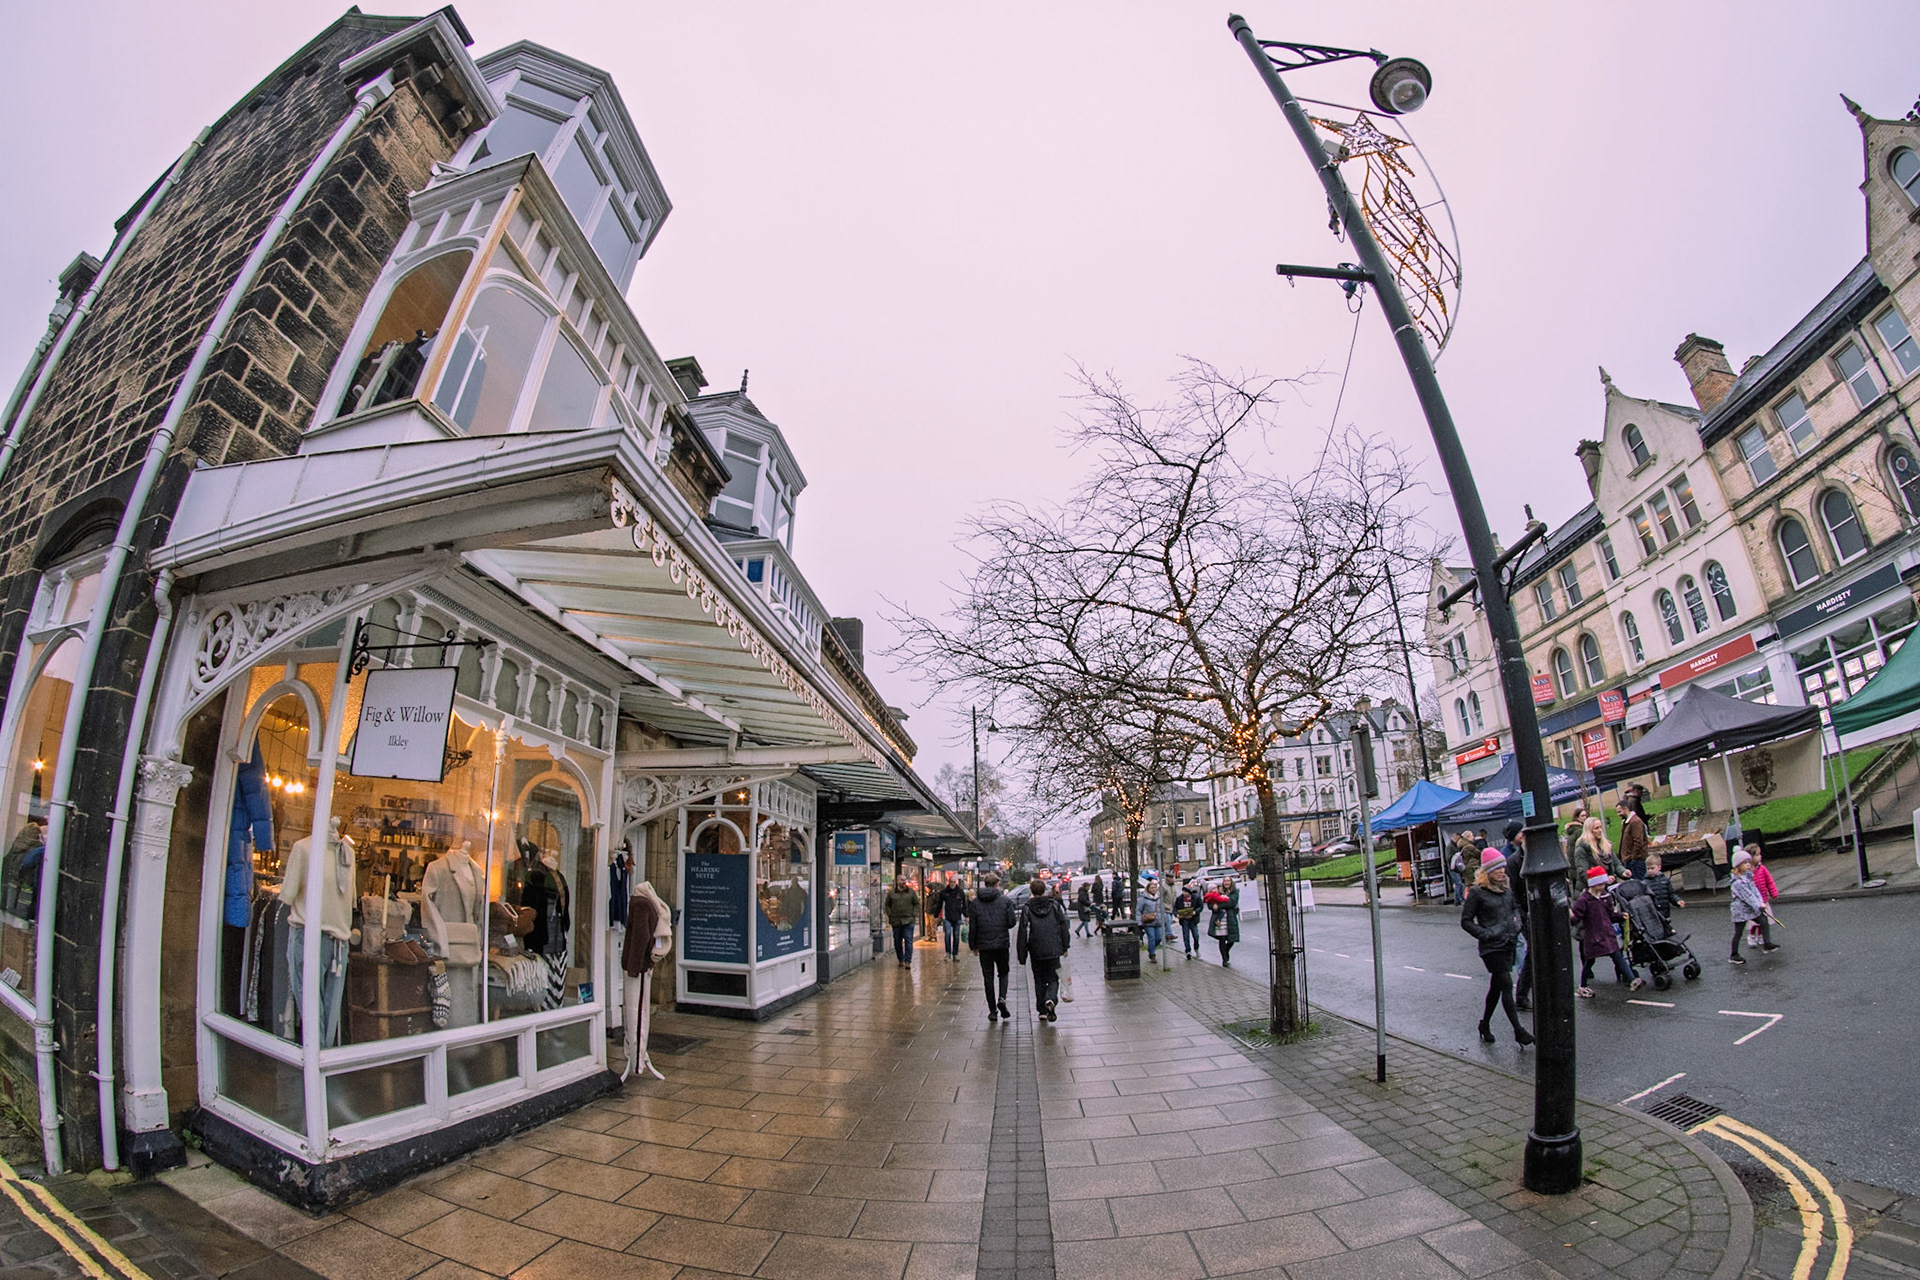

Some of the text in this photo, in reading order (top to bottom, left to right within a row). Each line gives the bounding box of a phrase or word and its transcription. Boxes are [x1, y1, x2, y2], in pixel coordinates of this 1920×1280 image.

[1816, 589, 1852, 612] HARDISTY
[1826, 601, 1846, 613] PRESTIGE
[1690, 653, 1719, 669] HARDISTY
[365, 705, 444, 728] Fig & Willow
[388, 734, 409, 750] Ilkley
[1587, 744, 1596, 752] TO
[1587, 751, 1600, 759] Retail
